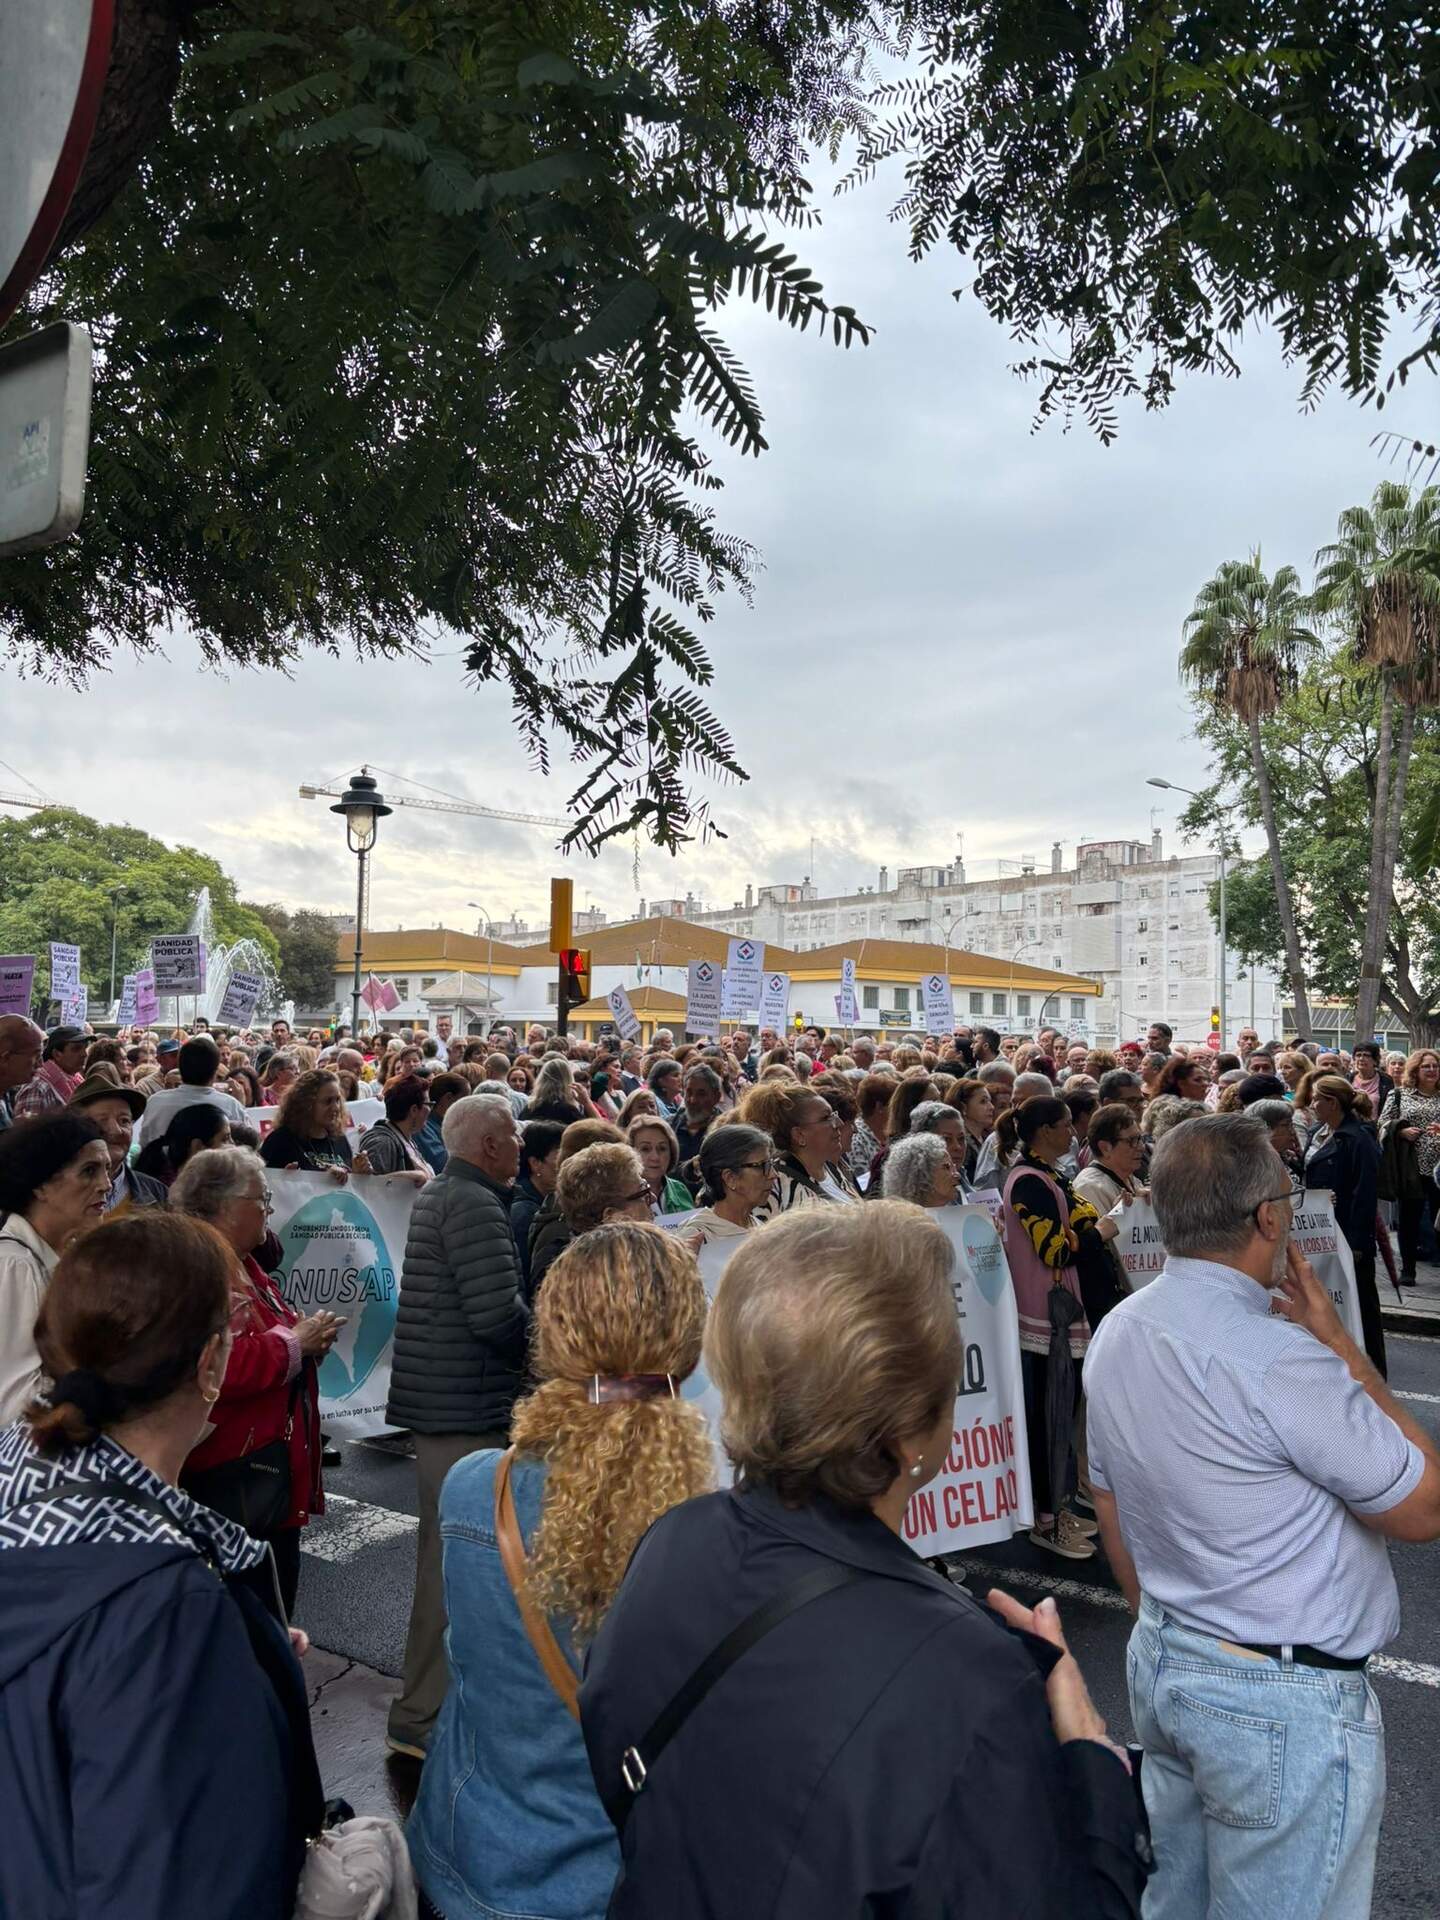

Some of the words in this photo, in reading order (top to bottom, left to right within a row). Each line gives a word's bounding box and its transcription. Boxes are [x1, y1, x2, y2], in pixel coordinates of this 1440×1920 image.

[155, 940, 193, 948] SANIDAD
[155, 948, 193, 956] PÚBLICA
[233, 972, 261, 986] SANIDAD
[1294, 1214, 1308, 1230] DE
[1132, 1226, 1142, 1244] EL
[1138, 1254, 1145, 1270] A
[1147, 1253, 1158, 1269] LA
[352, 1407, 363, 1417] por
[943, 1416, 1006, 1475] CIÓN
